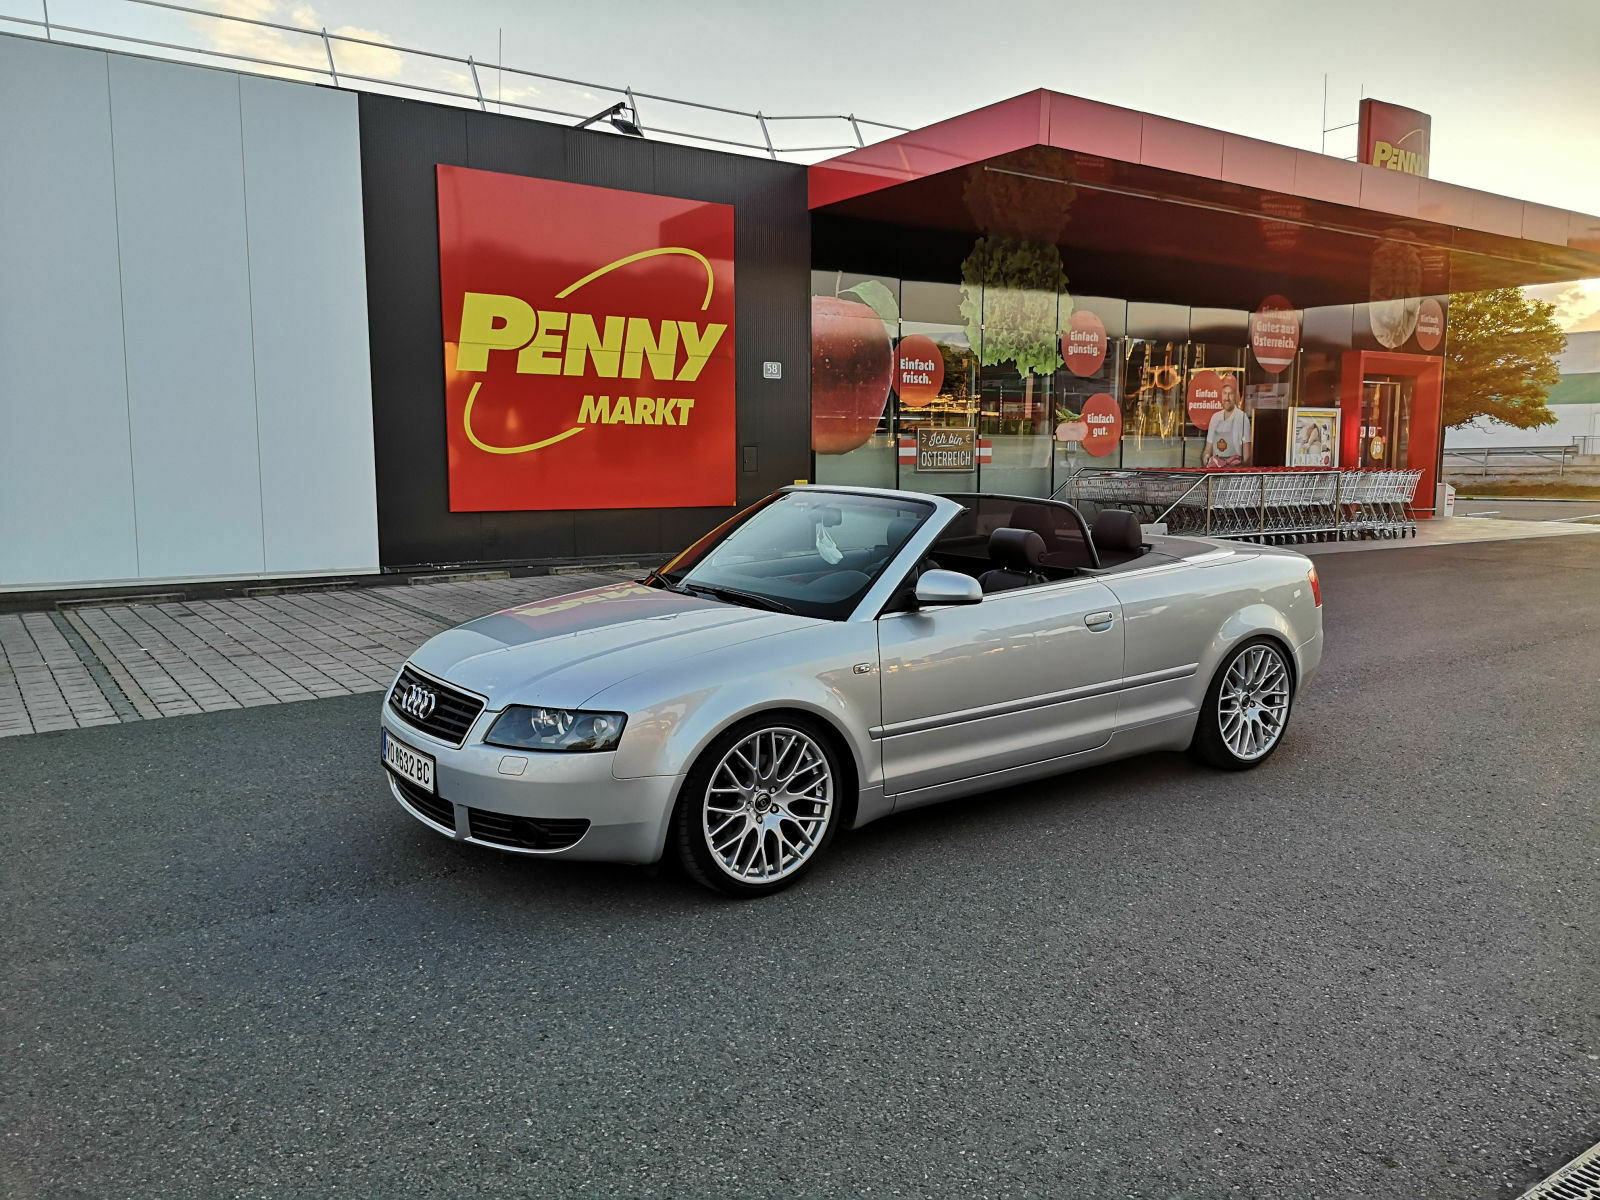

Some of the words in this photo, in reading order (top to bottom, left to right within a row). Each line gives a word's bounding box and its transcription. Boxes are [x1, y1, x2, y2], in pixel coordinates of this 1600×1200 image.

[1256, 321, 1280, 333] Gutes
[456, 291, 728, 382] PENNY
[1070, 331, 1099, 342] Einfach
[1254, 333, 1296, 348] Österreich.
[1068, 344, 1100, 356] günstig.
[766, 363, 778, 373] 58
[900, 357, 935, 371] Einfach
[902, 371, 932, 384] frisch.
[1195, 389, 1218, 398] Einfach
[576, 395, 695, 426] MARKT
[1087, 413, 1115, 424] Einfach
[1093, 427, 1108, 437] gut.
[929, 432, 947, 446] Ich
[949, 433, 963, 445] bin
[921, 448, 971, 467] ÖSTERREICH
[416, 758, 430, 785] BC
